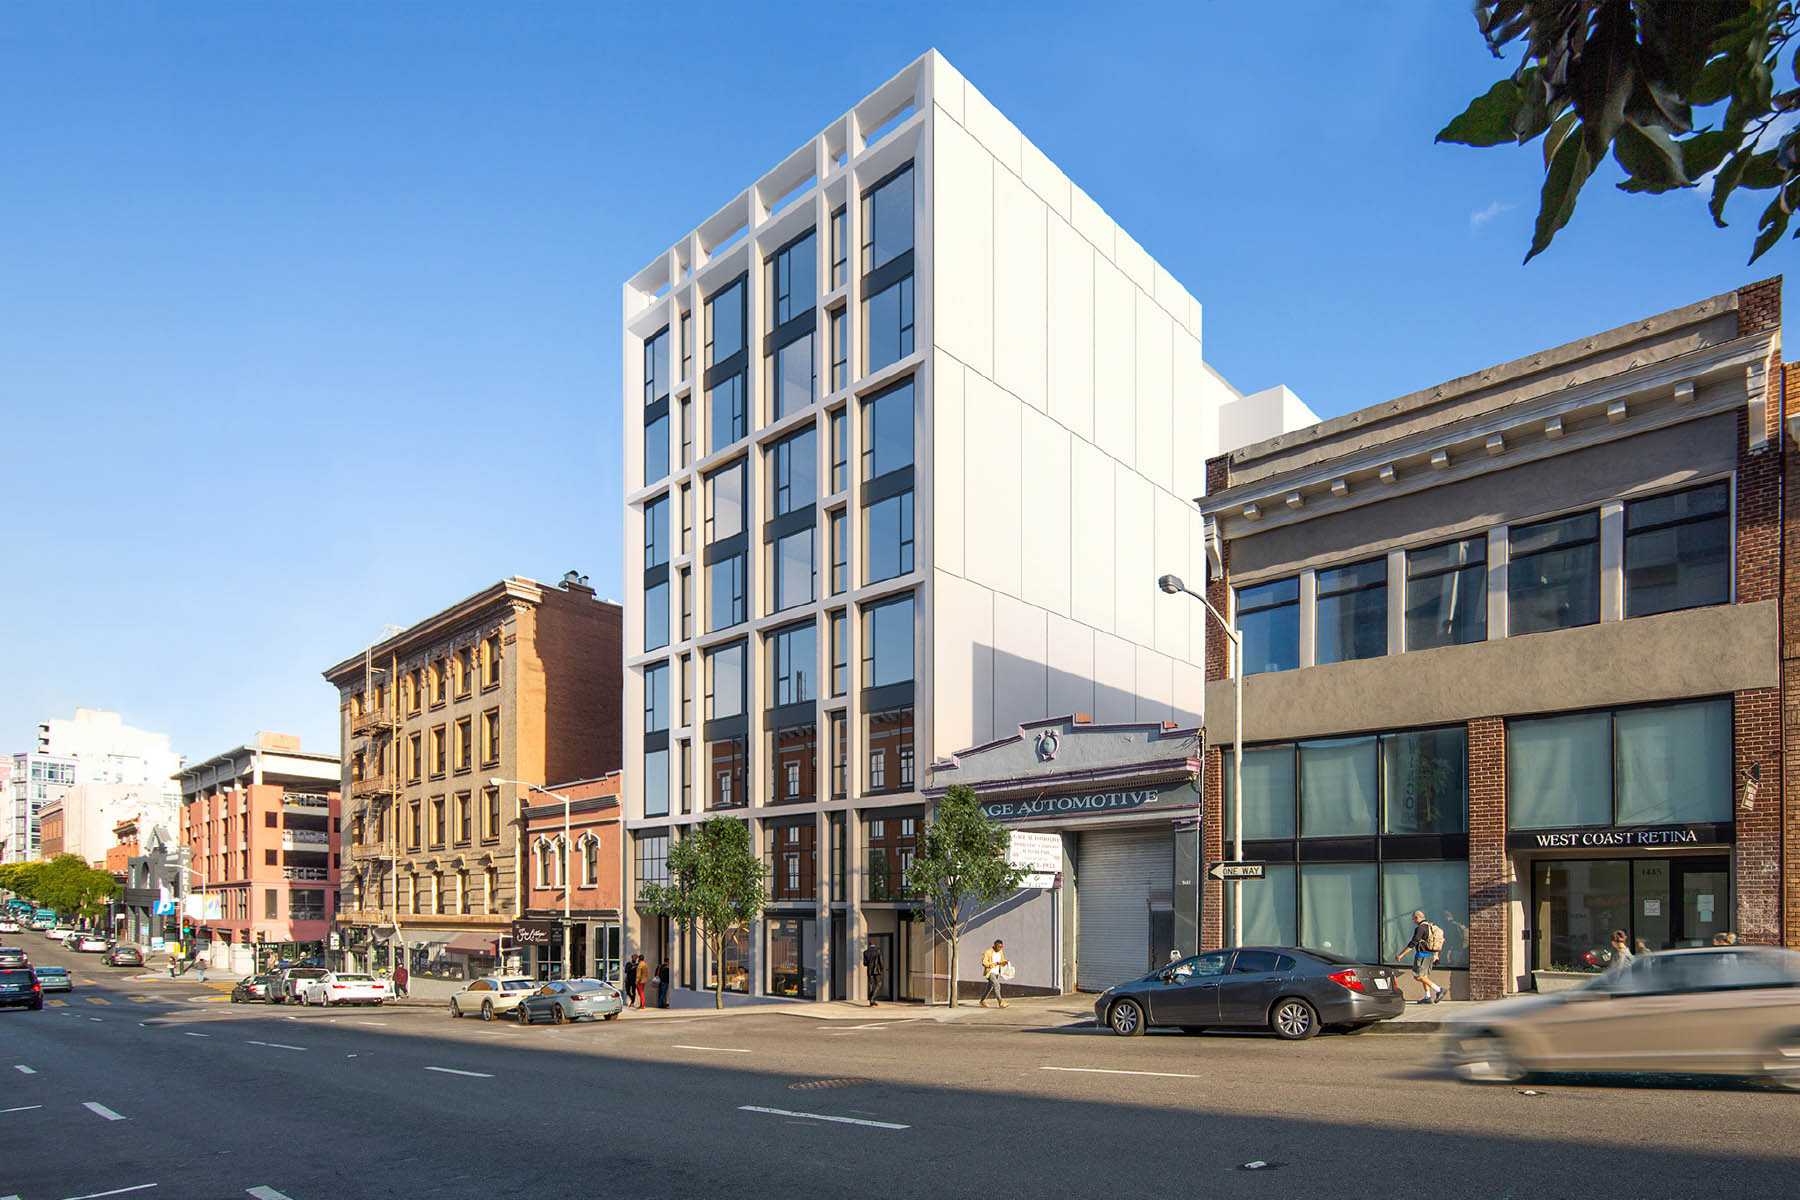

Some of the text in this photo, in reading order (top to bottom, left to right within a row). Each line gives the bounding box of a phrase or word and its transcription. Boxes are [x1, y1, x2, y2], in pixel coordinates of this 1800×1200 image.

[1016, 789, 1158, 815] AUTOMOTIVE
[1536, 830, 1698, 847] WEST COAST RETINA
[1223, 867, 1260, 875] ONE WAY
